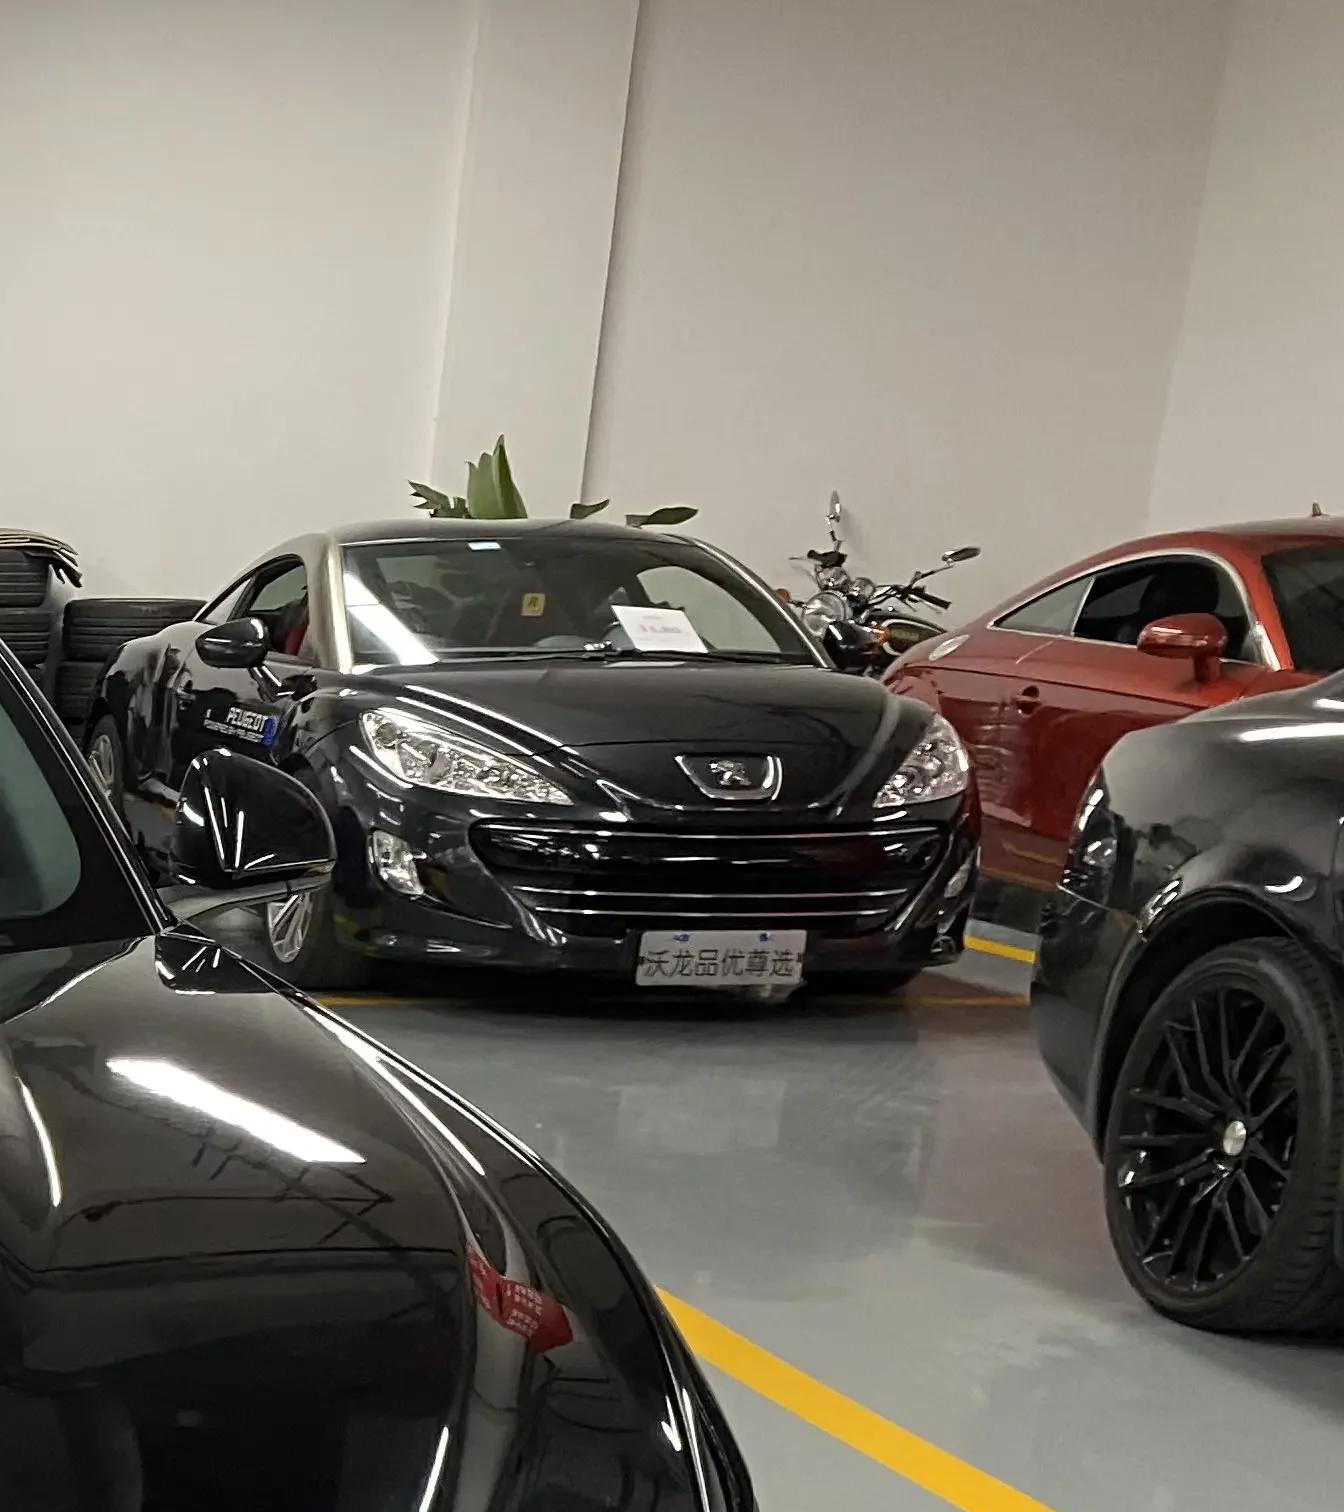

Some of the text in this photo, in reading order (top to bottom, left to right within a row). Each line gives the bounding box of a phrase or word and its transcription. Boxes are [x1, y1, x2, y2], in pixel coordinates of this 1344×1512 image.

[644, 949, 793, 977] 沃龙品优尊选
